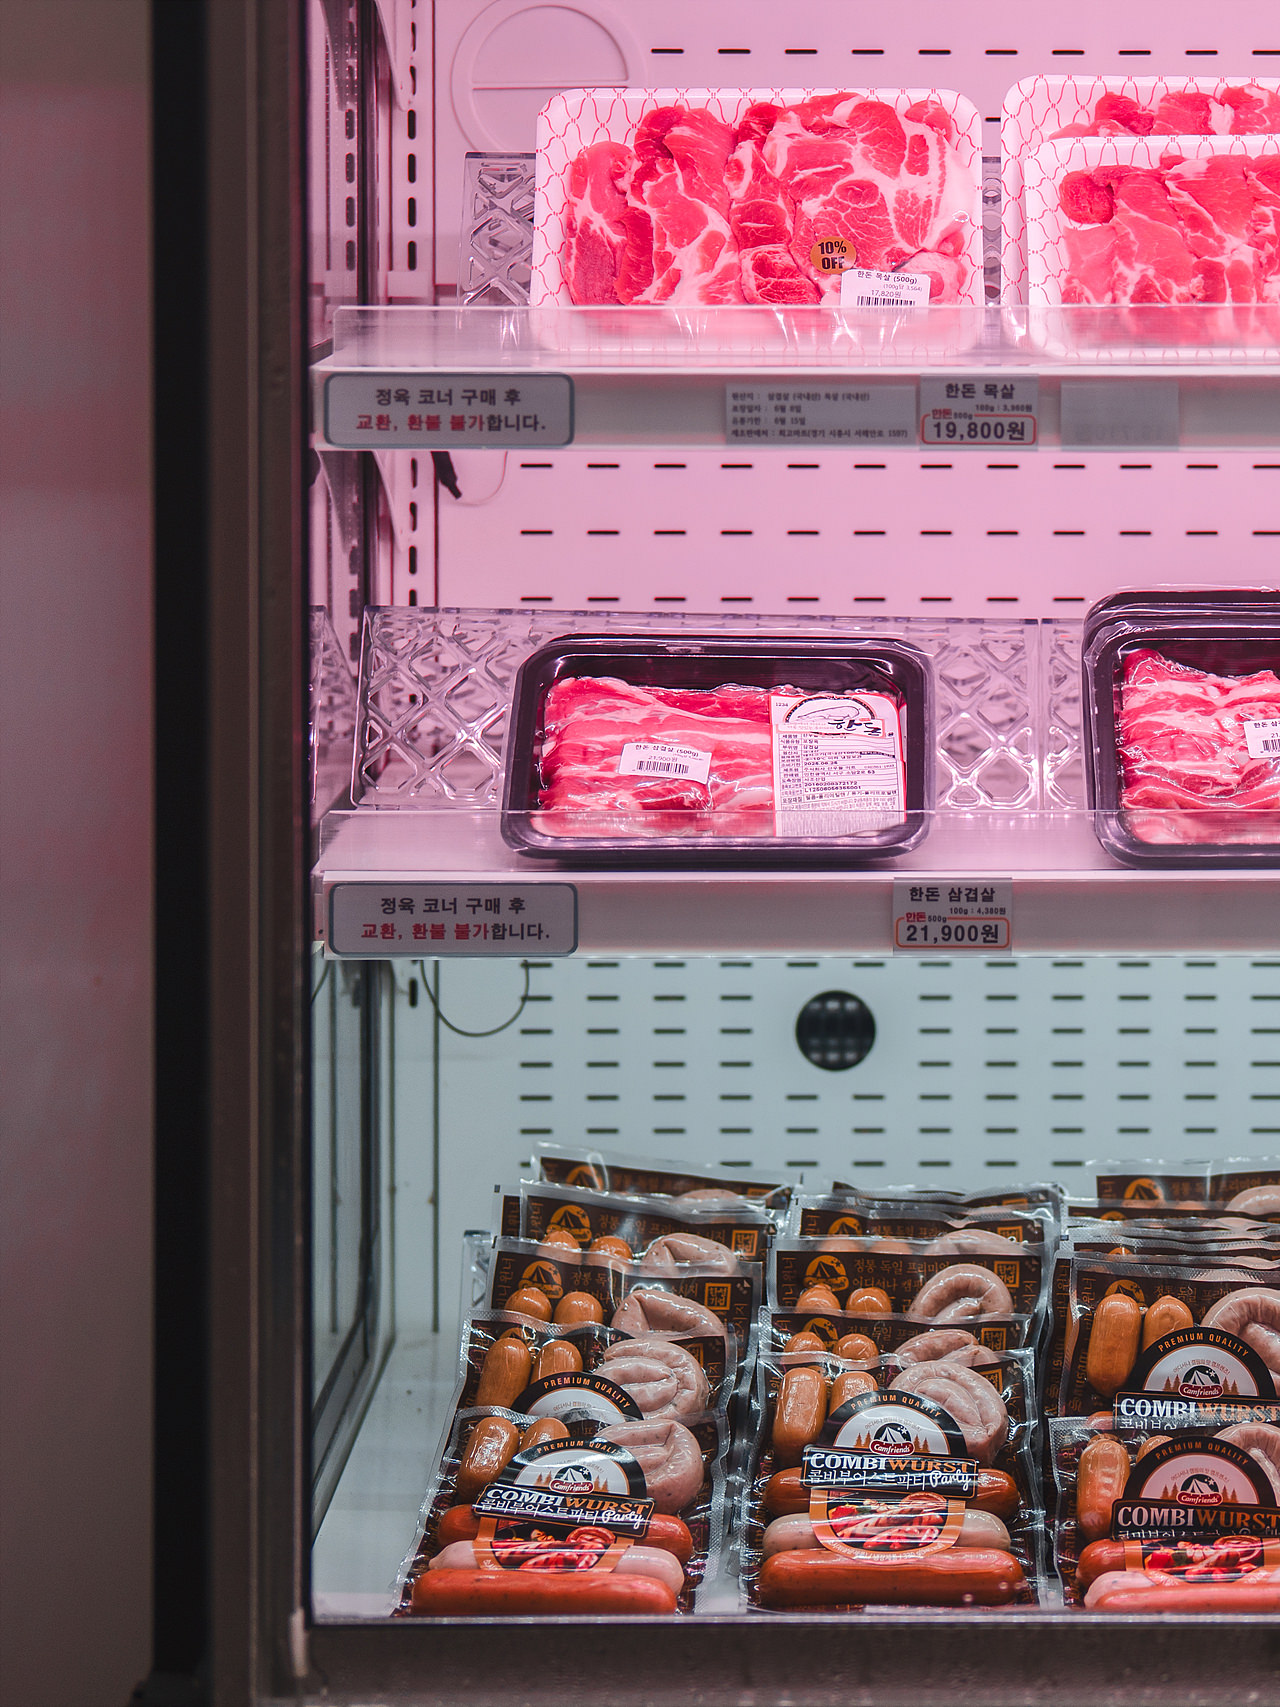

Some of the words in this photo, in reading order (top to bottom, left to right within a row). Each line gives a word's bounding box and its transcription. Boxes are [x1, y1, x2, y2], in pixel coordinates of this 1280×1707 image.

[818, 240, 847, 254] 10%
[822, 256, 845, 270] OFF
[894, 275, 918, 284] (500g)
[871, 290, 902, 298] 17,820원
[375, 388, 410, 406] 정육
[419, 388, 454, 406] 코너
[461, 388, 496, 406] 구매
[504, 388, 521, 406] 후
[946, 383, 976, 399] 한돈
[984, 383, 1016, 400] 목살
[976, 404, 994, 412] 100g
[356, 414, 399, 432] 교환,
[407, 414, 442, 432] 환불
[450, 414, 547, 432] 불가합니다.
[934, 421, 1025, 441] 19,800원
[676, 749, 699, 757] (500g)
[909, 886, 940, 902] 한돈
[948, 887, 996, 902] 삼겹살
[380, 897, 415, 914] 정육
[422, 897, 458, 914] 코너
[465, 897, 500, 914] 구매
[508, 897, 526, 914] 후
[950, 907, 968, 915] 100g
[976, 907, 1006, 916] 4,380원
[360, 923, 404, 941] 교환,
[412, 923, 446, 940] 환불
[454, 923, 550, 941] 불가합니다.
[906, 924, 998, 944] 21,900원
[1158, 1333, 1204, 1352] PREMIUM
[1208, 1334, 1249, 1358] QUALITY
[544, 1376, 590, 1389] PREMIUM
[594, 1382, 631, 1410] QUALITY
[1183, 1386, 1220, 1398] Camfriends
[850, 1394, 898, 1410] PREMIUM
[902, 1396, 942, 1418] QUALITY
[537, 1440, 584, 1454] PREMIUM
[588, 1441, 627, 1463] QUALI
[873, 1444, 910, 1454] Camfriends
[1156, 1442, 1202, 1460] PREMIUM
[1208, 1442, 1249, 1466] QUALITY
[810, 1452, 970, 1474] COMBIWURST
[929, 1469, 972, 1490] Party
[553, 1483, 590, 1494] Camfriends
[486, 1488, 650, 1516] COMBIWURST
[1180, 1494, 1219, 1504] Camfriends
[602, 1510, 644, 1530] Party
